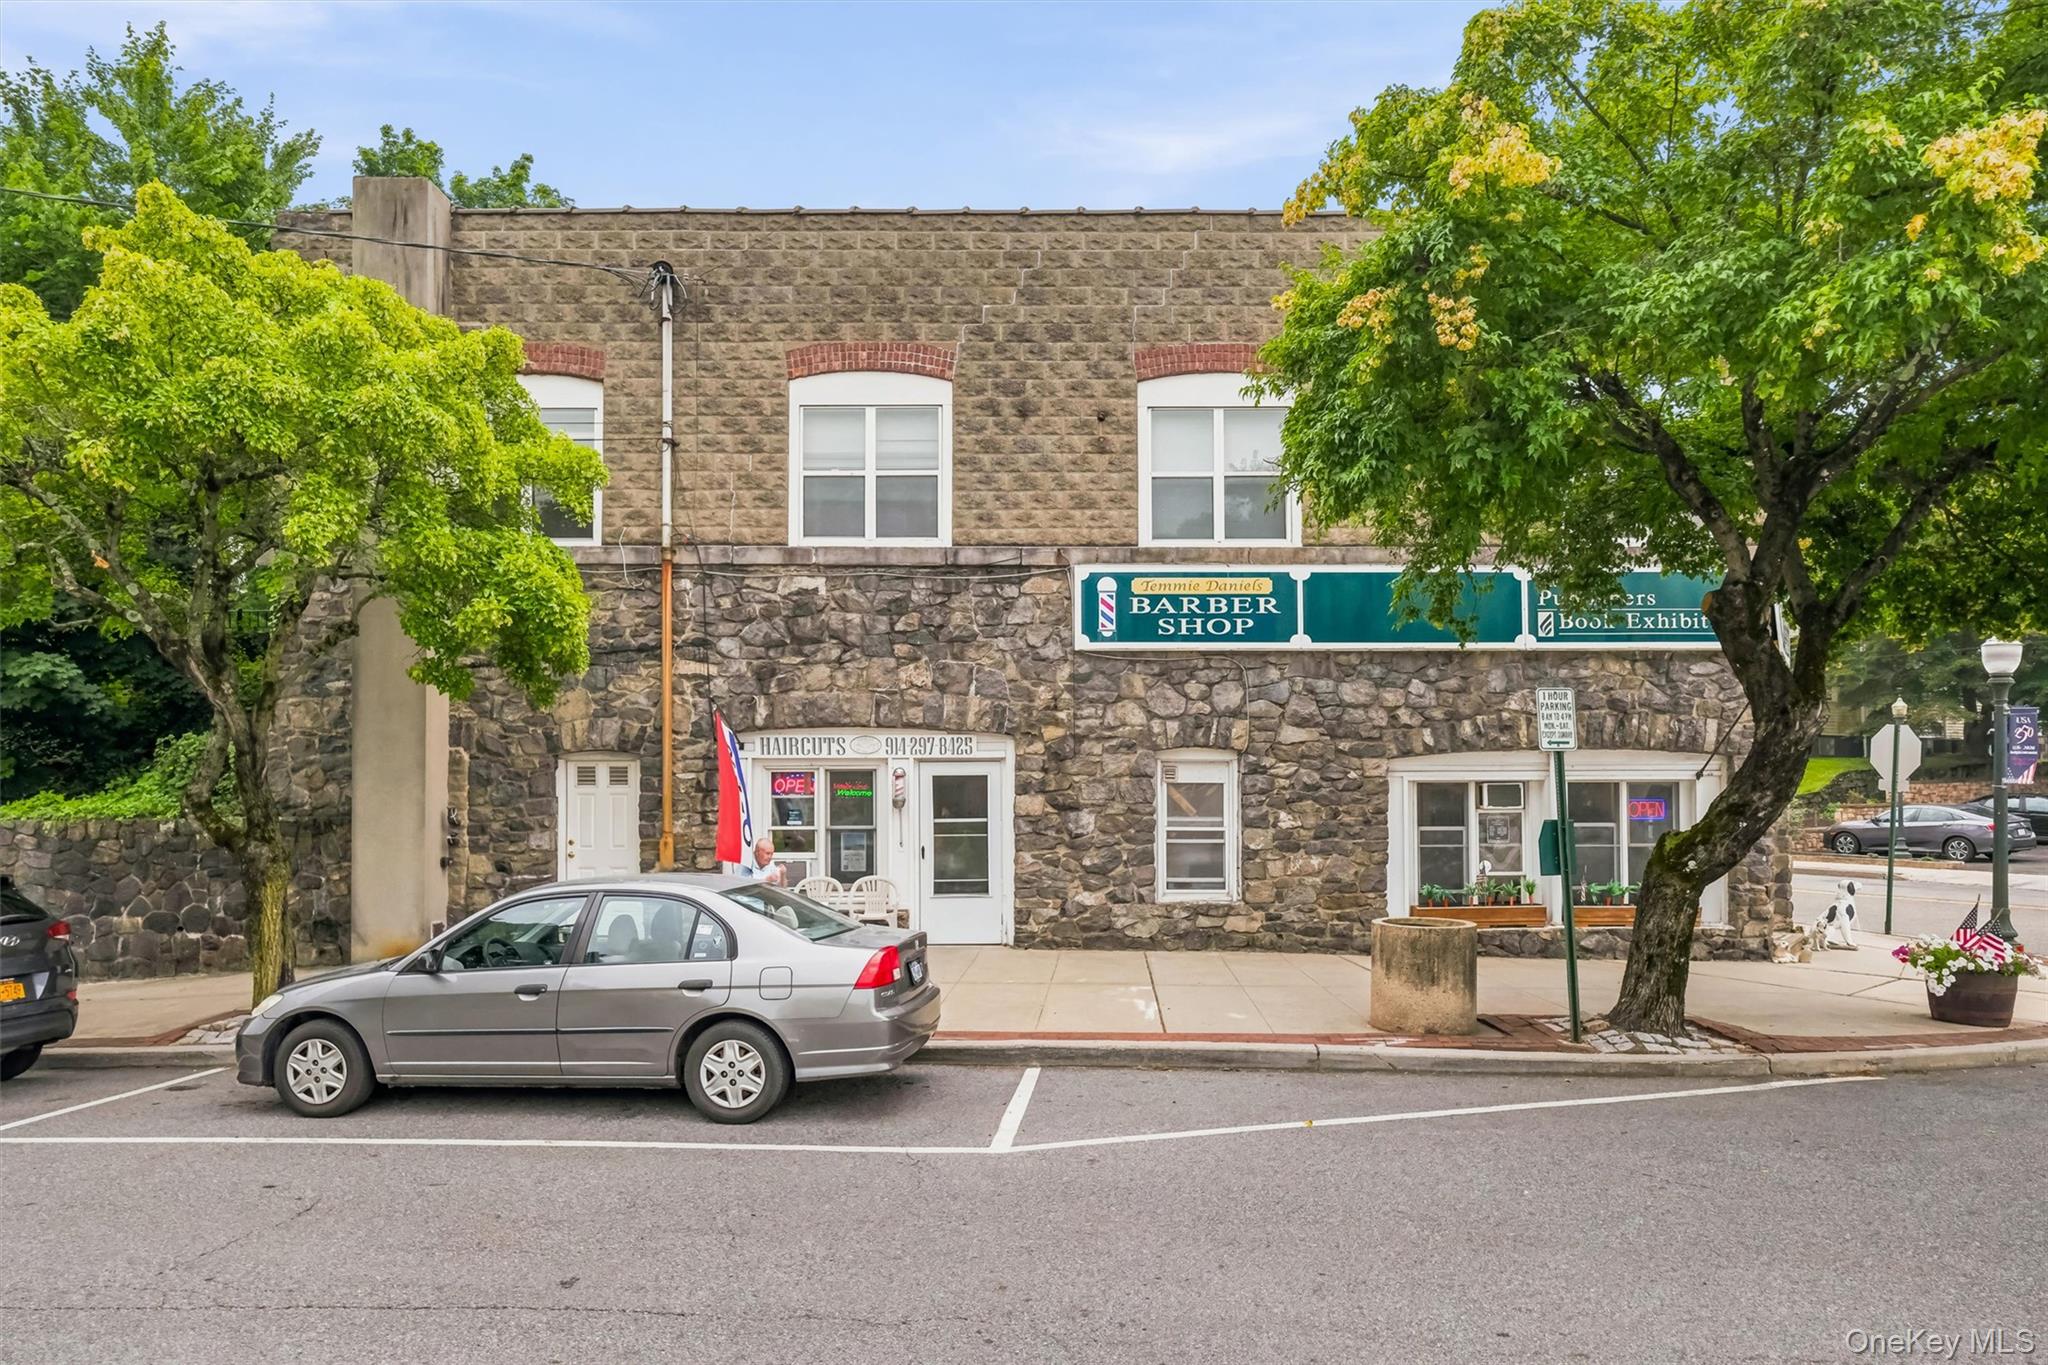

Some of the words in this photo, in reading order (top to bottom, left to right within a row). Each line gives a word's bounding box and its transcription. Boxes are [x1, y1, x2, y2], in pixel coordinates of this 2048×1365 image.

[1206, 578, 1263, 592] Daniels
[1129, 597, 1281, 614] BARBER
[1158, 618, 1255, 635] SHOP
[1625, 612, 1709, 629] Exhibit
[1548, 692, 1568, 700] HOUR
[1540, 702, 1572, 711] PARKING
[759, 736, 846, 756] HAIRCUTS
[837, 788, 872, 797] Welcome
[1628, 801, 1665, 818] OPEN
